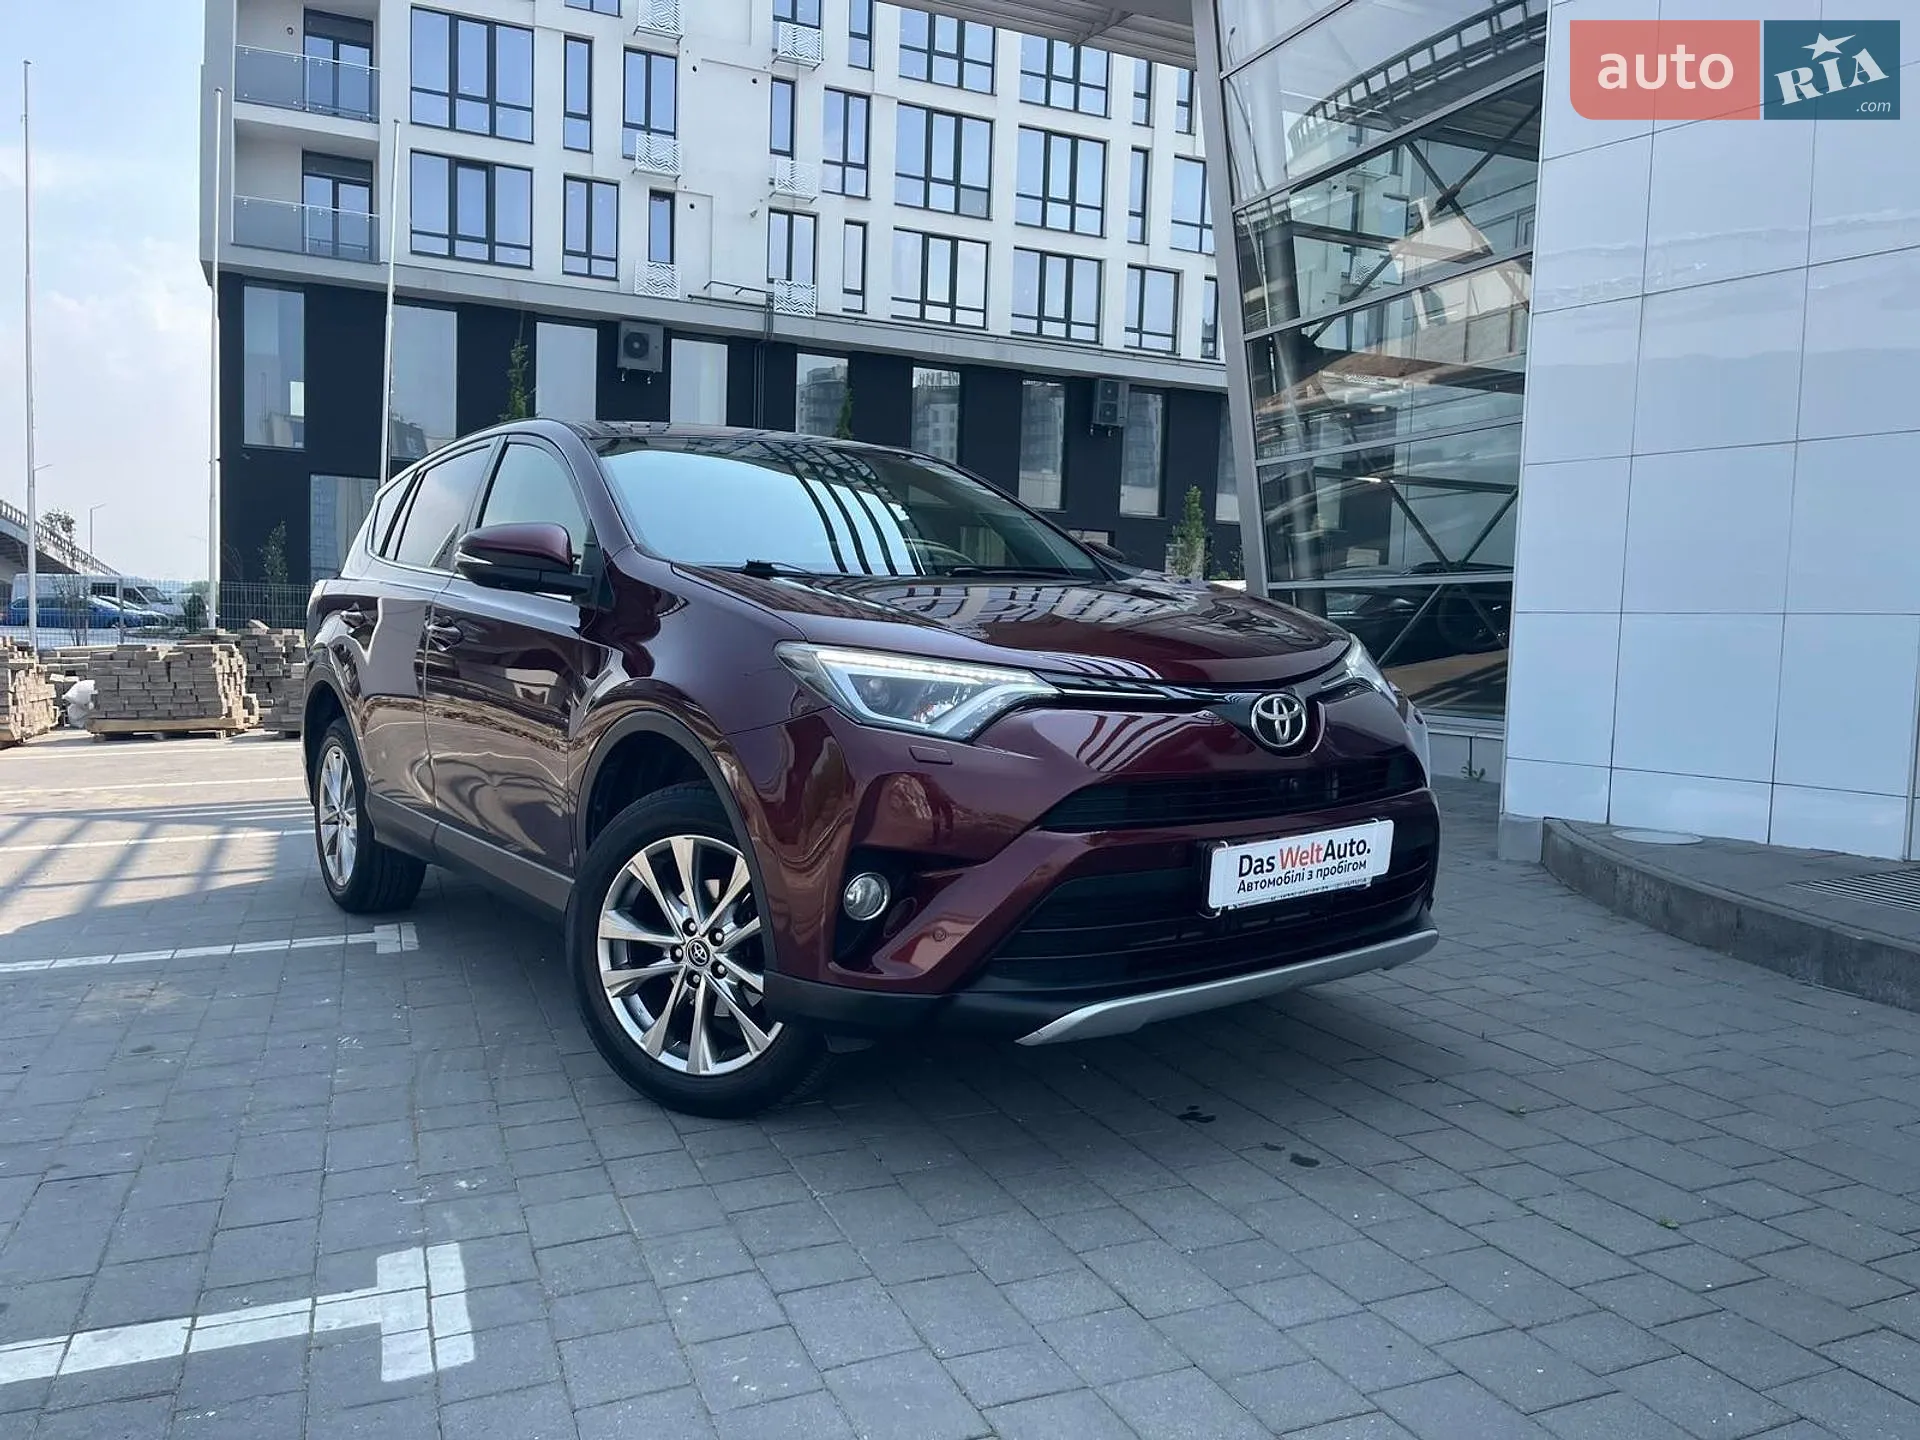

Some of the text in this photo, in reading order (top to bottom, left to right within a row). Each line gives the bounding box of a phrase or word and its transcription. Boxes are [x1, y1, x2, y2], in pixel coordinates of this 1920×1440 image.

[1237, 867, 1305, 894] Автомобілі
[1307, 872, 1313, 880] з
[1316, 858, 1367, 880] пробігом
[1238, 854, 1275, 878] Das
